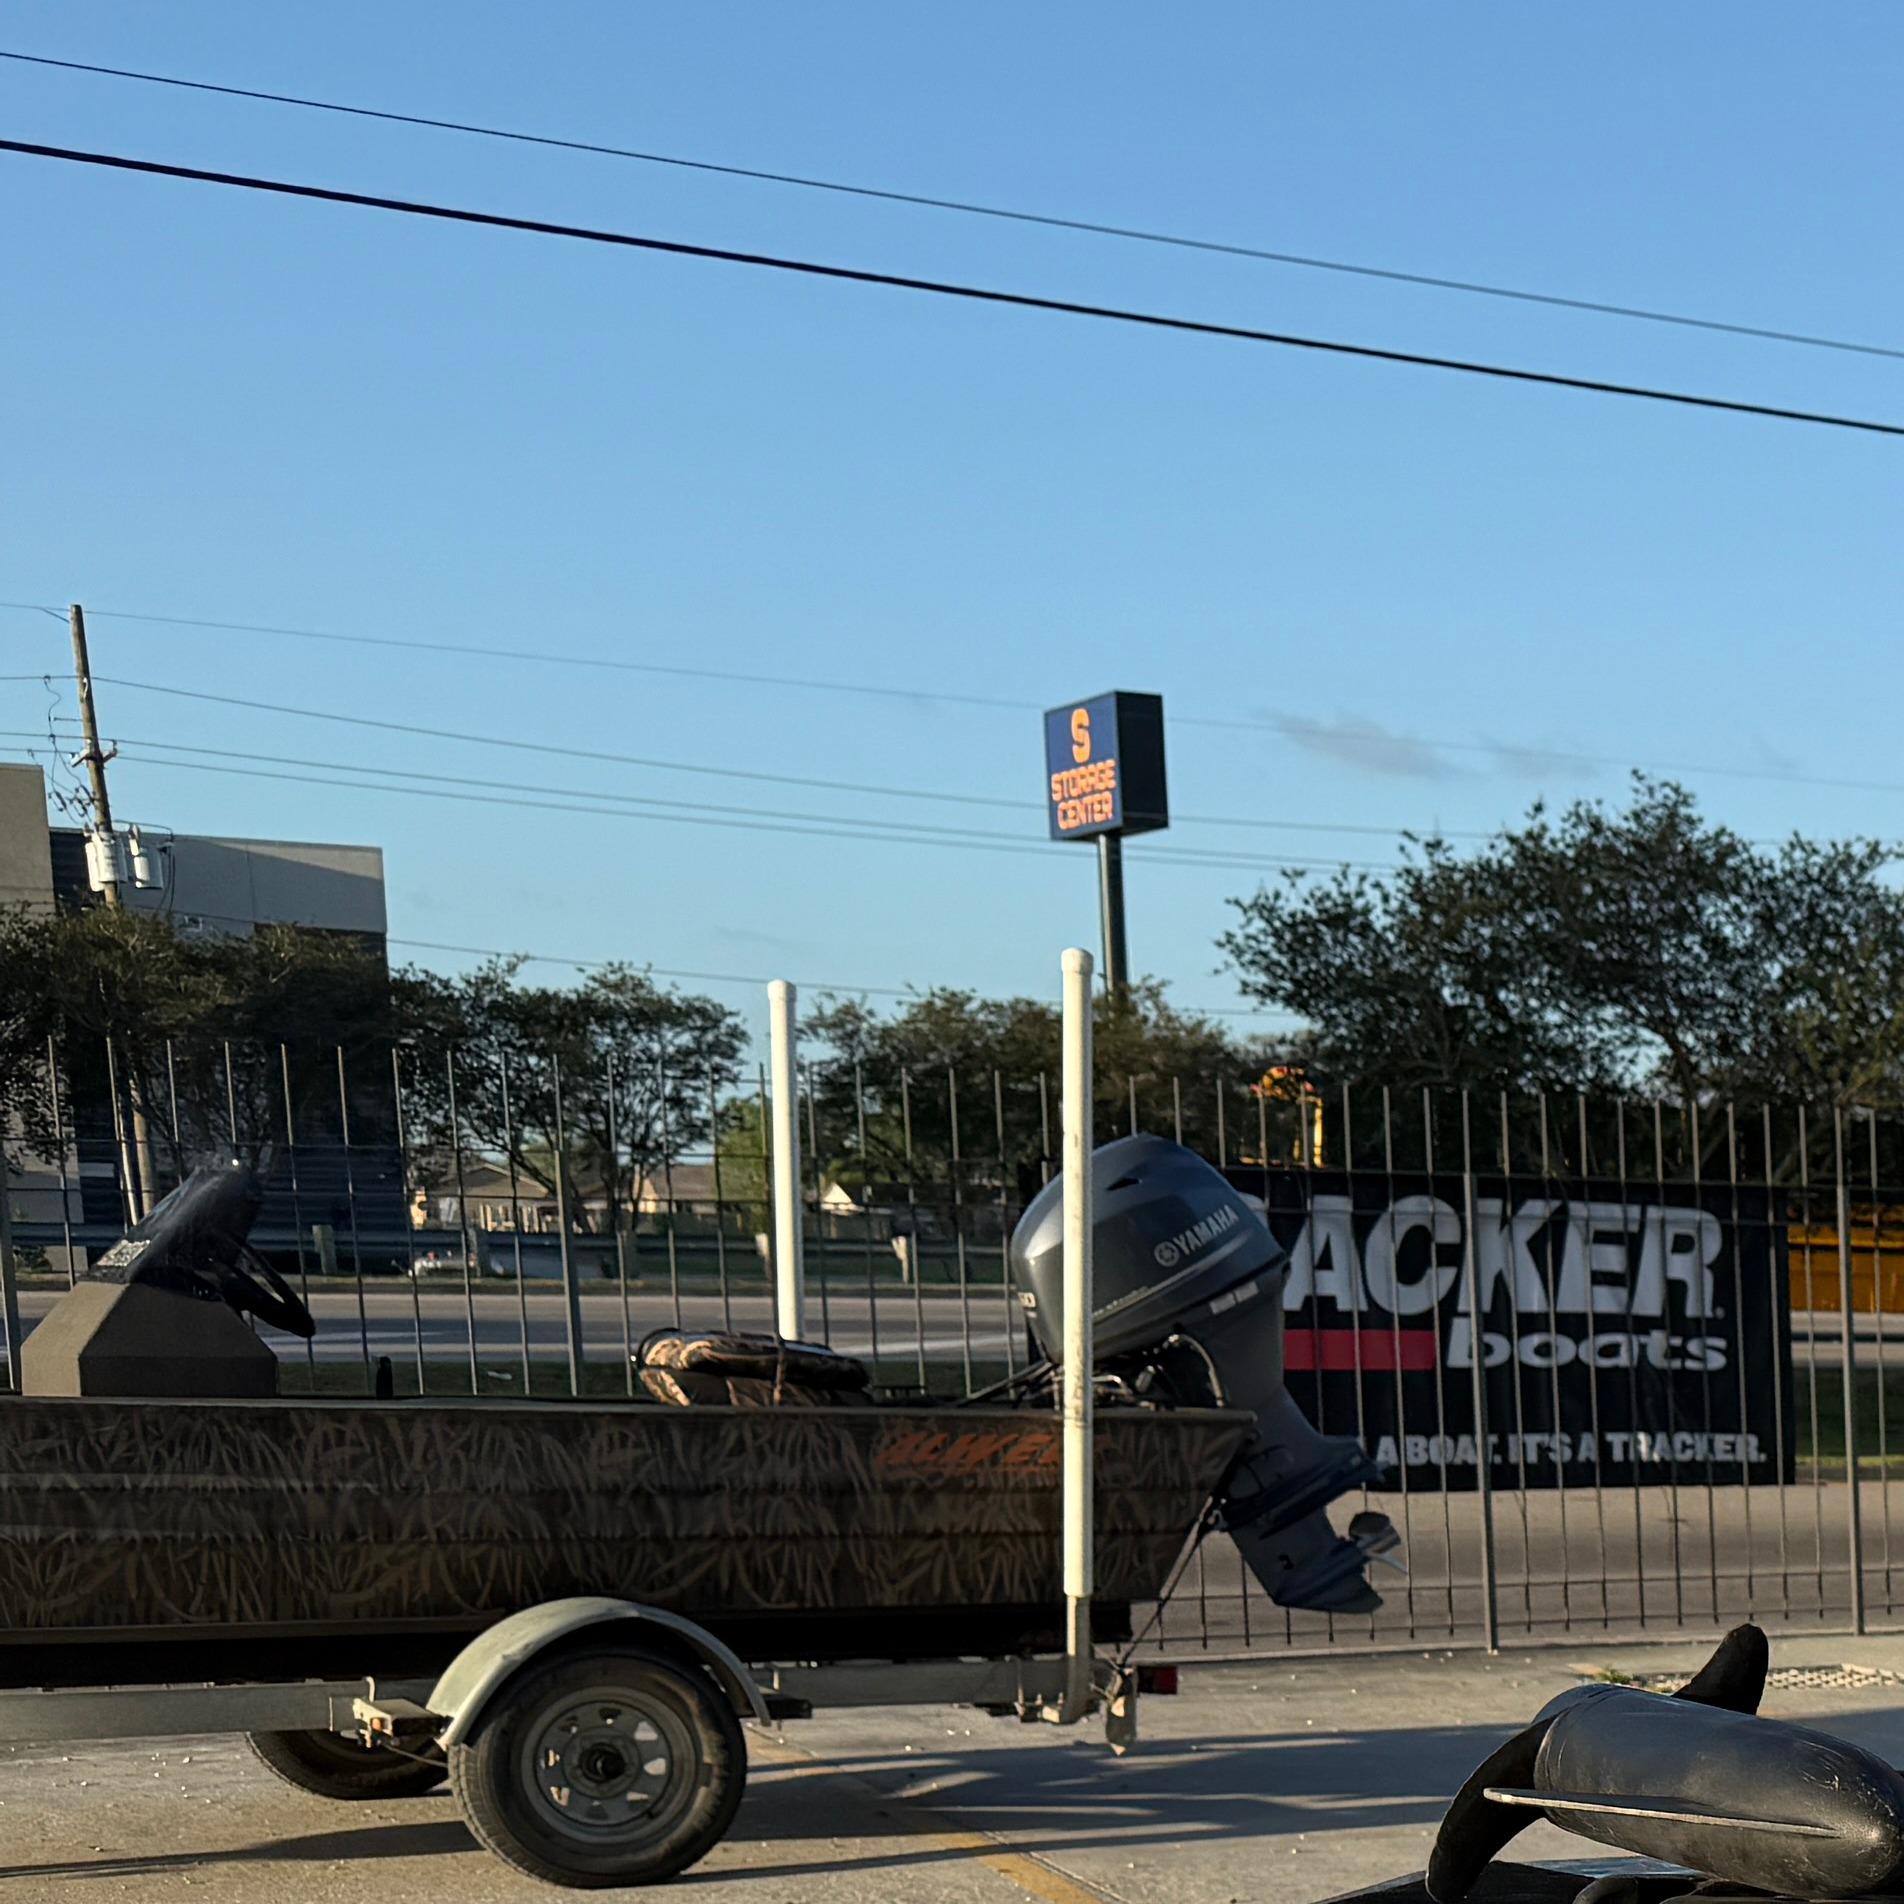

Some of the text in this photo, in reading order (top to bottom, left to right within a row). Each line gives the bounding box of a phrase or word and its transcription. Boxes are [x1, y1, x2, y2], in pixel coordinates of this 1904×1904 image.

[1051, 759, 1117, 801] STORAGE
[1057, 791, 1113, 830] CENTER
[1173, 1204, 1240, 1257] YAMAHA
[1240, 1193, 1722, 1318] ACKER
[1447, 1318, 1728, 1371] boats
[1405, 1434, 1502, 1466] BOAT.
[1508, 1433, 1573, 1464] IT'S
[1578, 1432, 1598, 1463] A
[1605, 1432, 1768, 1463] TRACKER.
